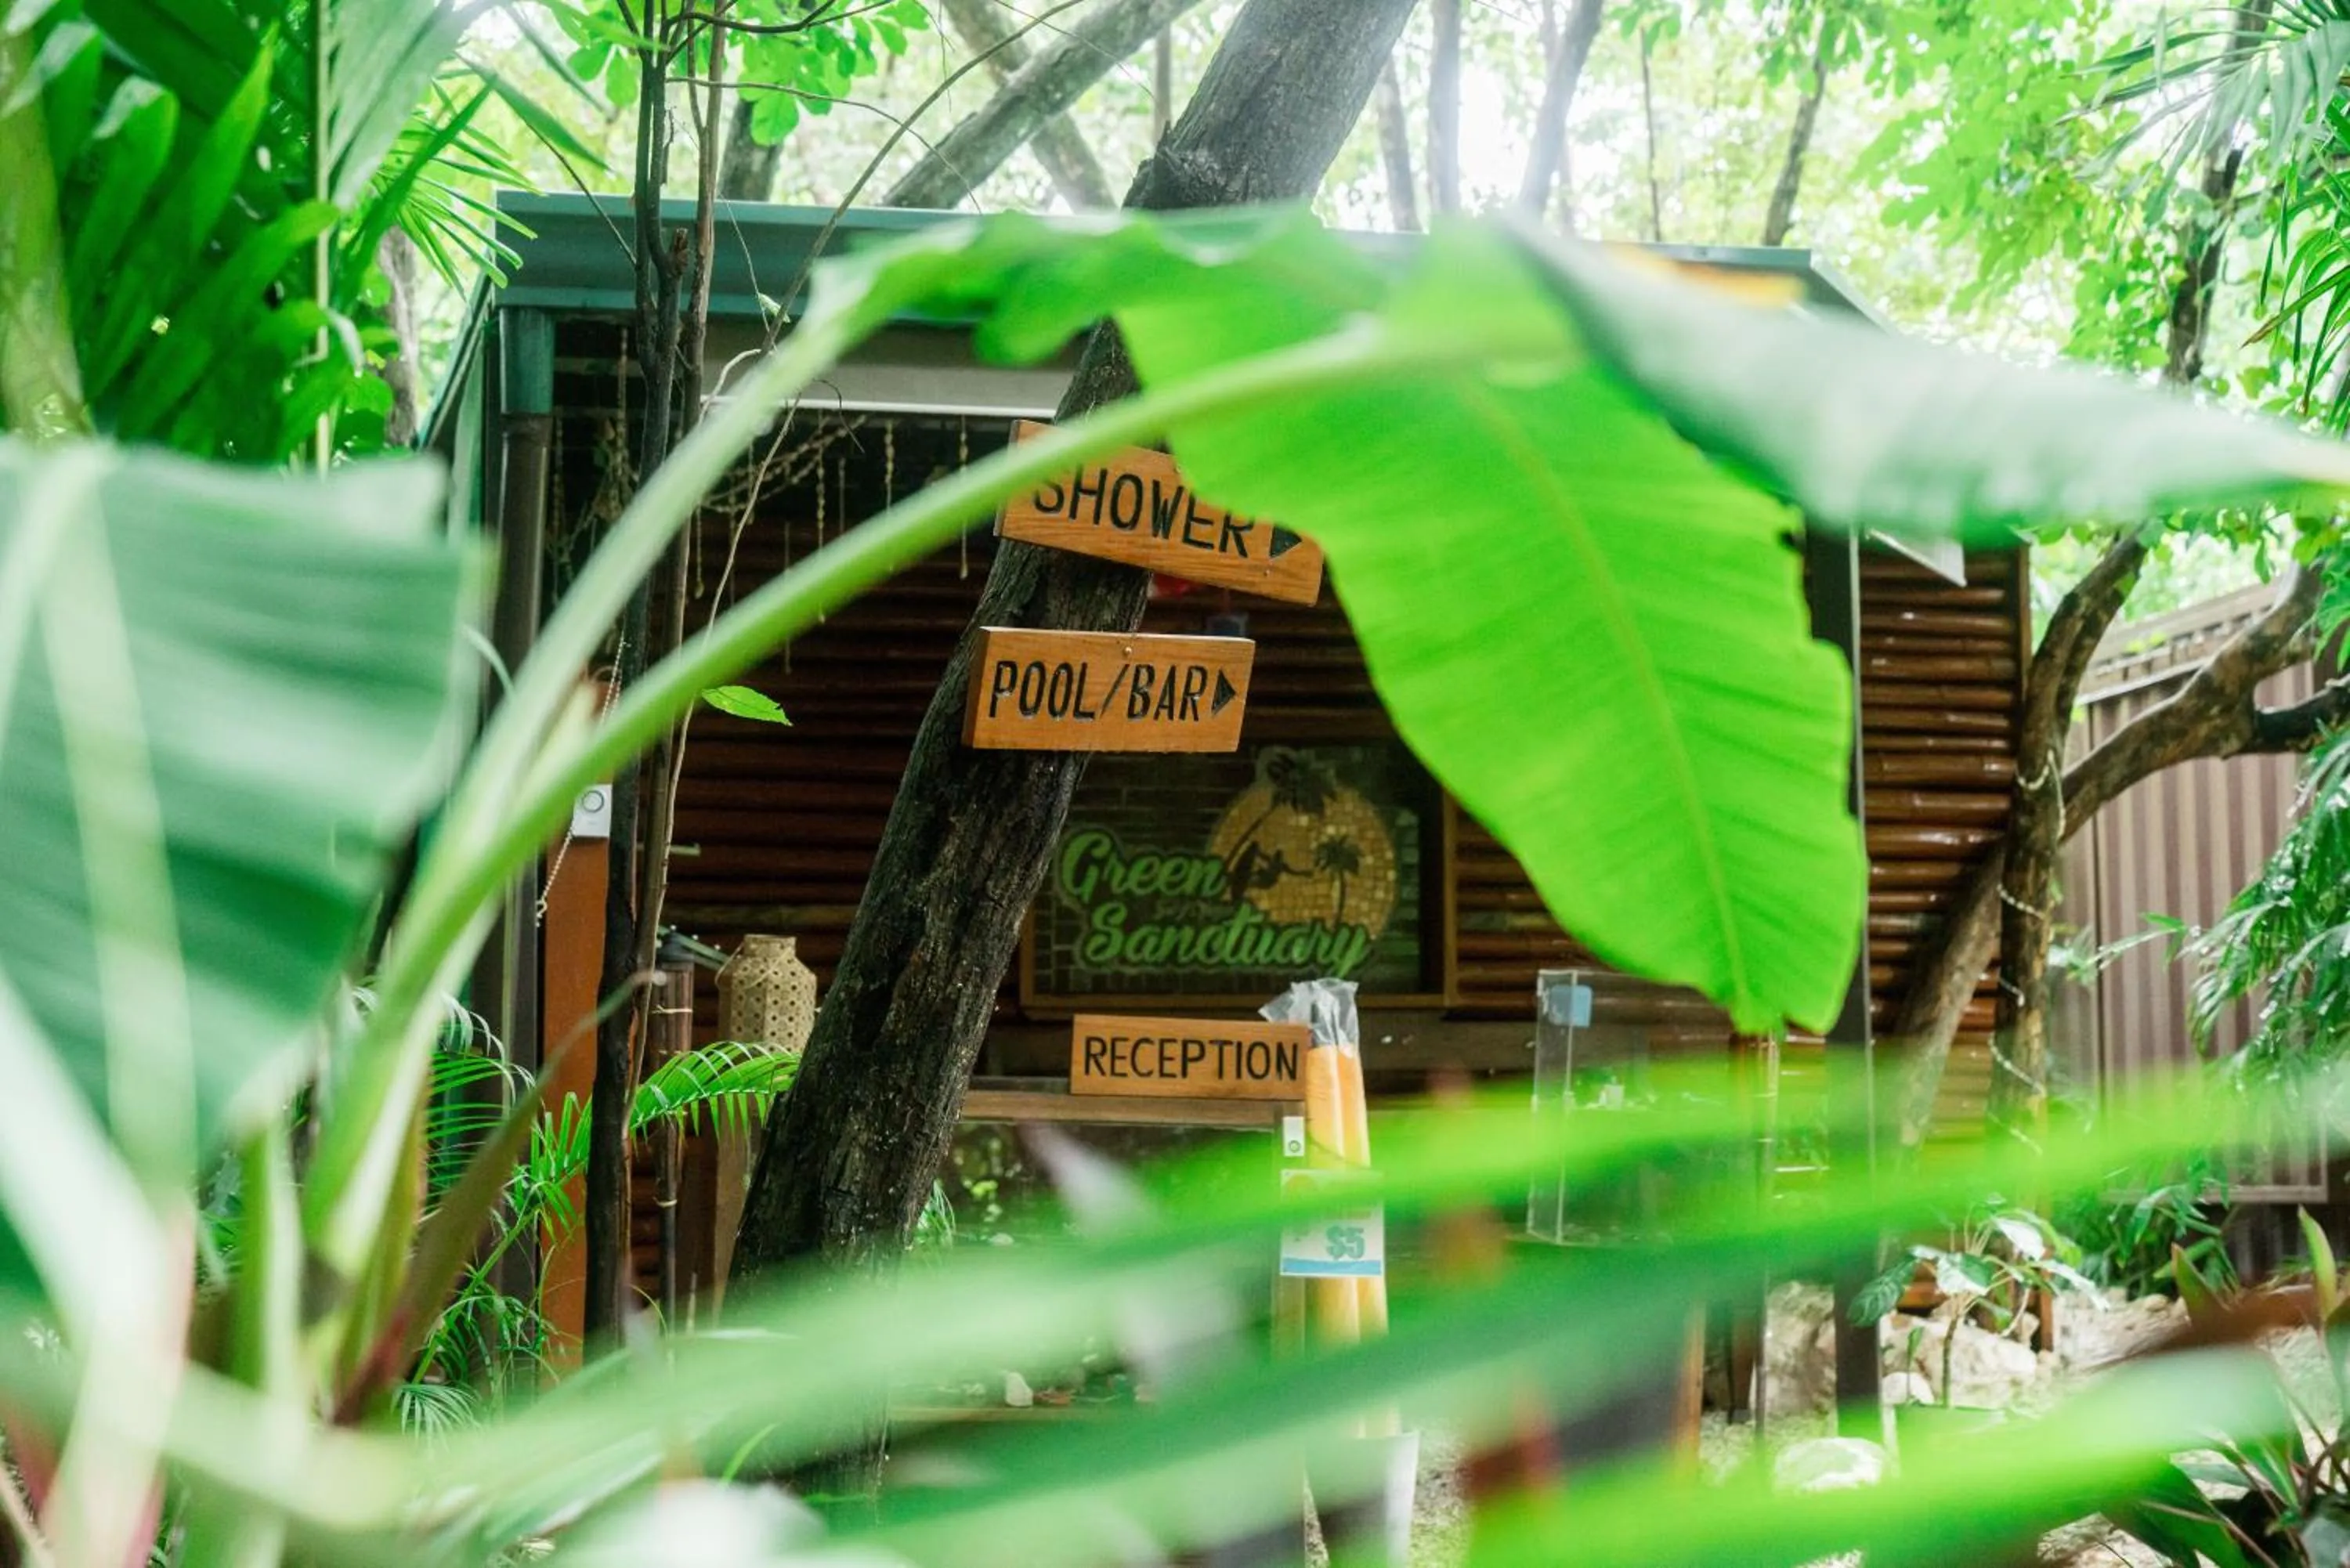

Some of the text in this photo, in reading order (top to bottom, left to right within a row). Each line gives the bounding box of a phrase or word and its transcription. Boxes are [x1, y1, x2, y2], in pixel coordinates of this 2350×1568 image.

[989, 660, 1208, 722] POOL/BAR
[1062, 828, 1227, 898] Green
[1086, 902, 1370, 979] Sanctuary
[1083, 1036, 1300, 1082] RECEPTION
